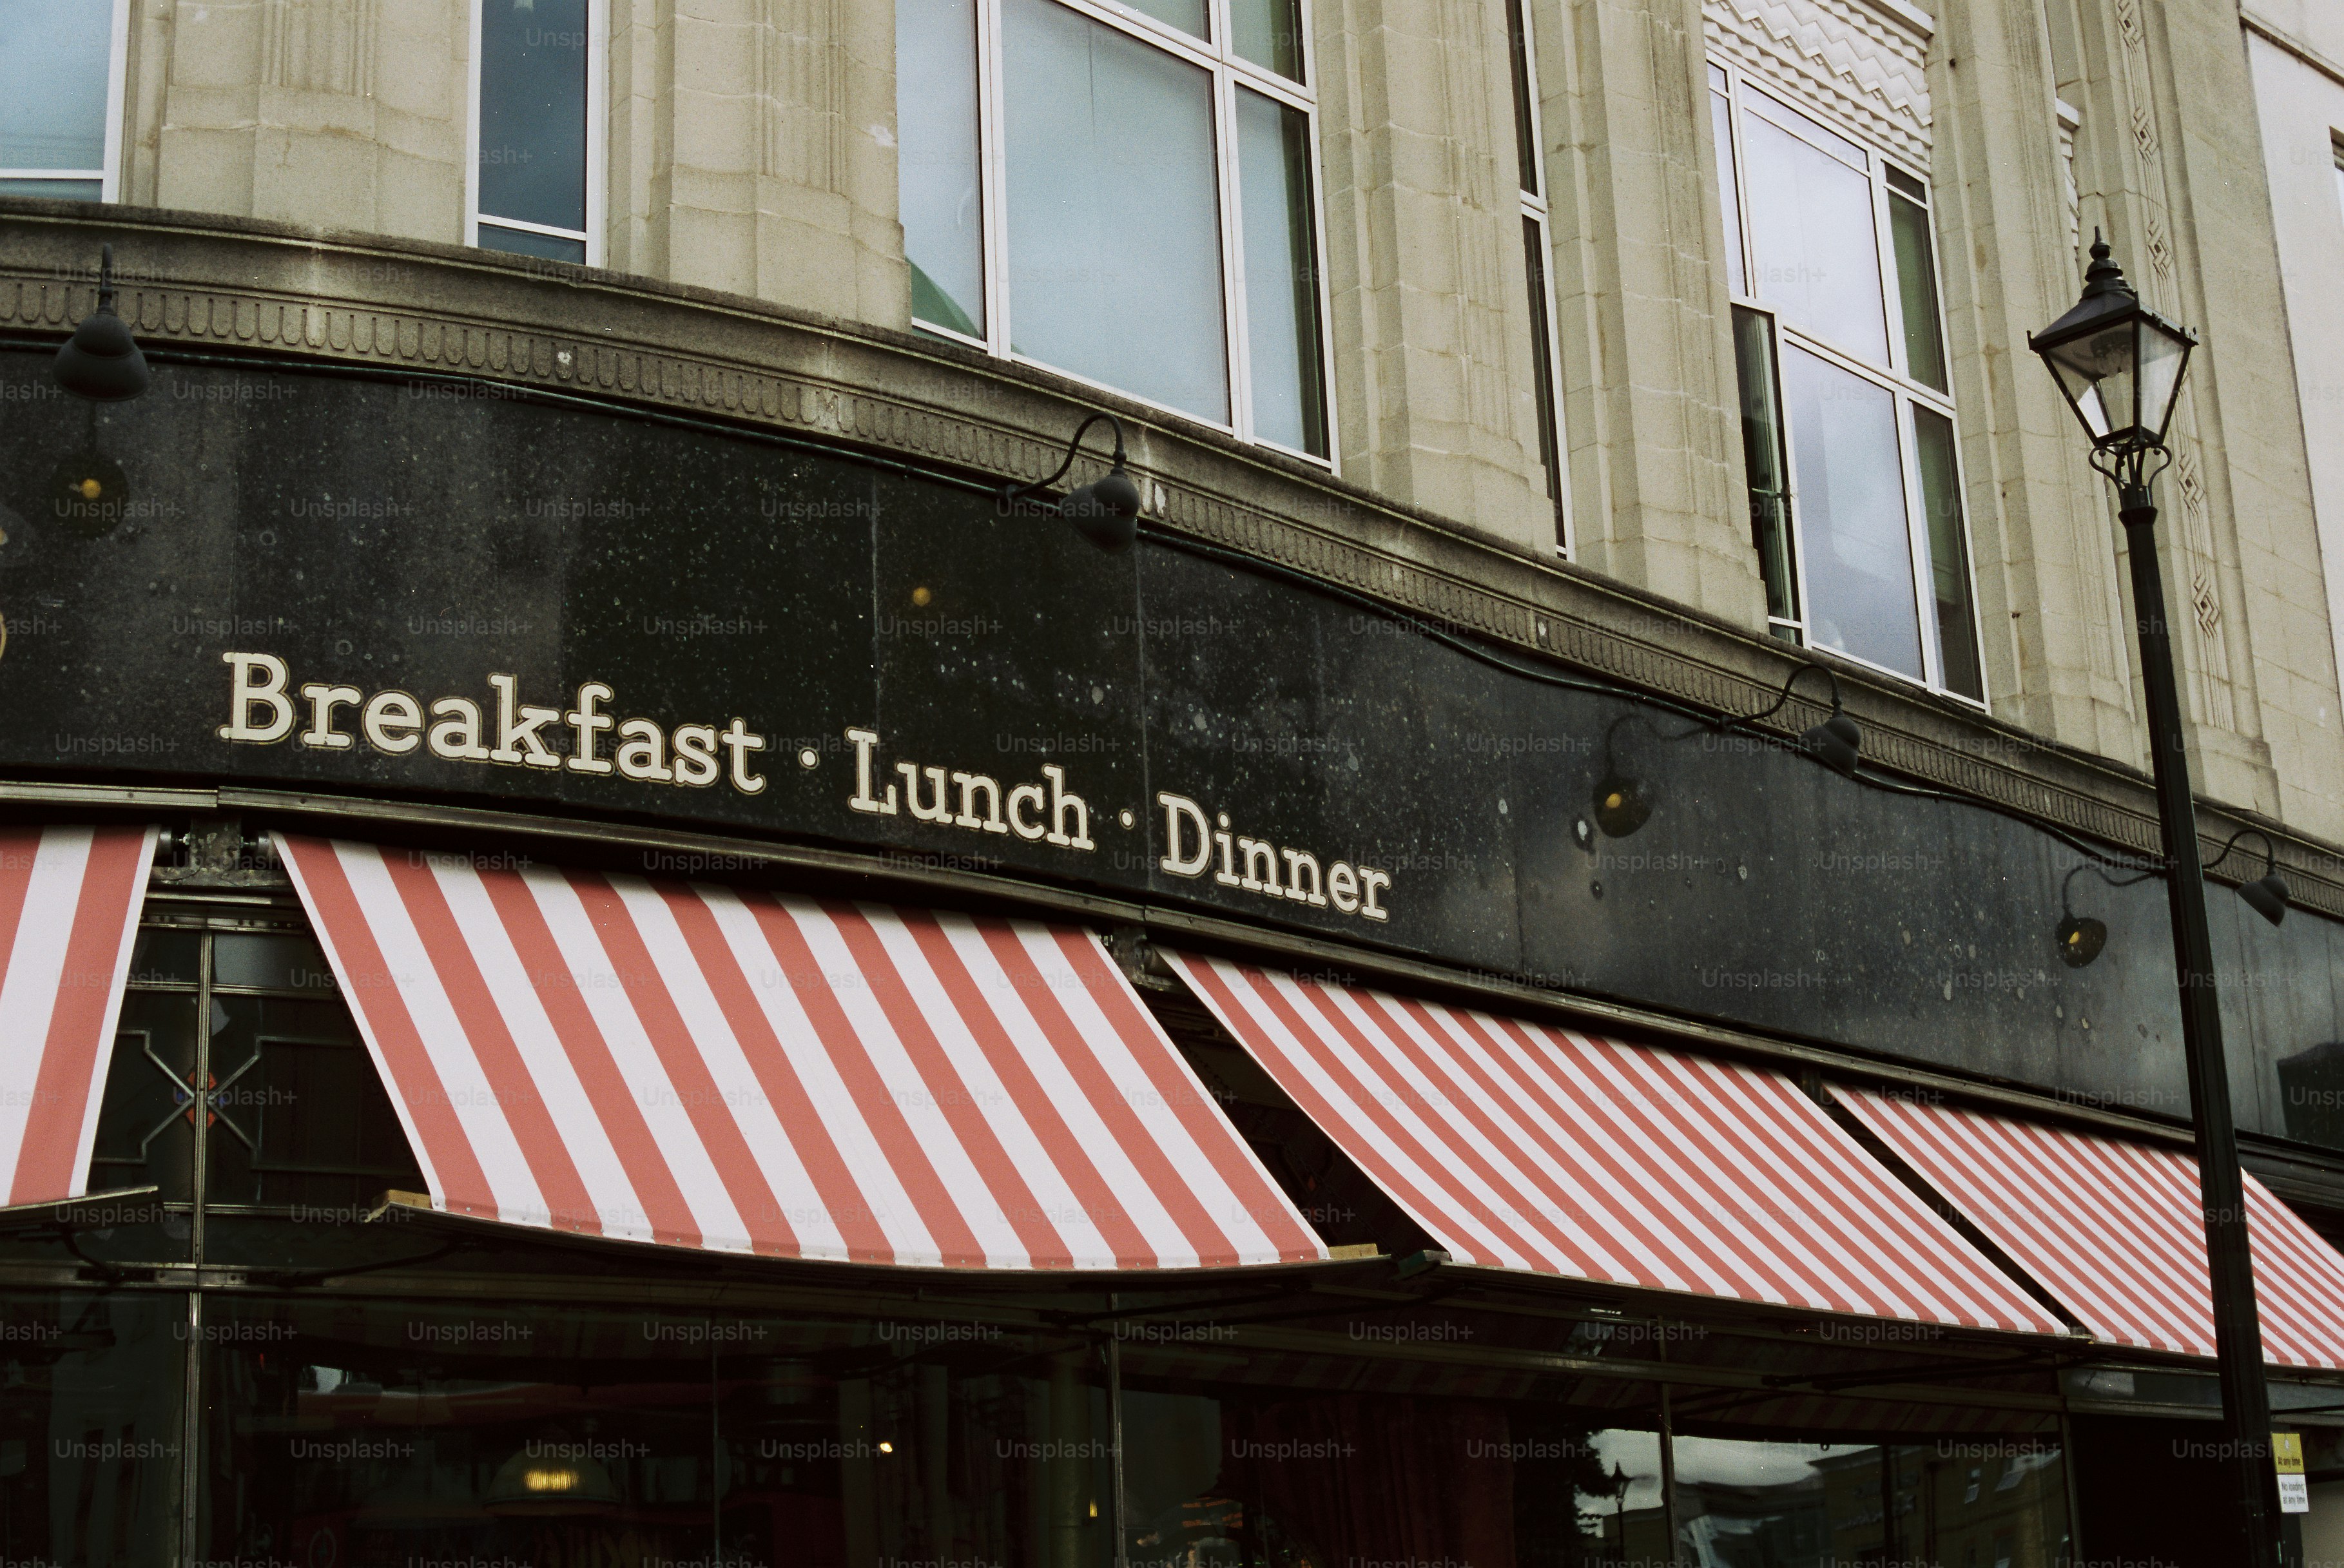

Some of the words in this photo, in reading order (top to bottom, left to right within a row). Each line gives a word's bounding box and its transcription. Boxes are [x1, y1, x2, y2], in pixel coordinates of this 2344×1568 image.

[217, 651, 766, 794] Breakfast
[845, 727, 1096, 851] Lunch
[1158, 791, 1391, 922] Dinner
